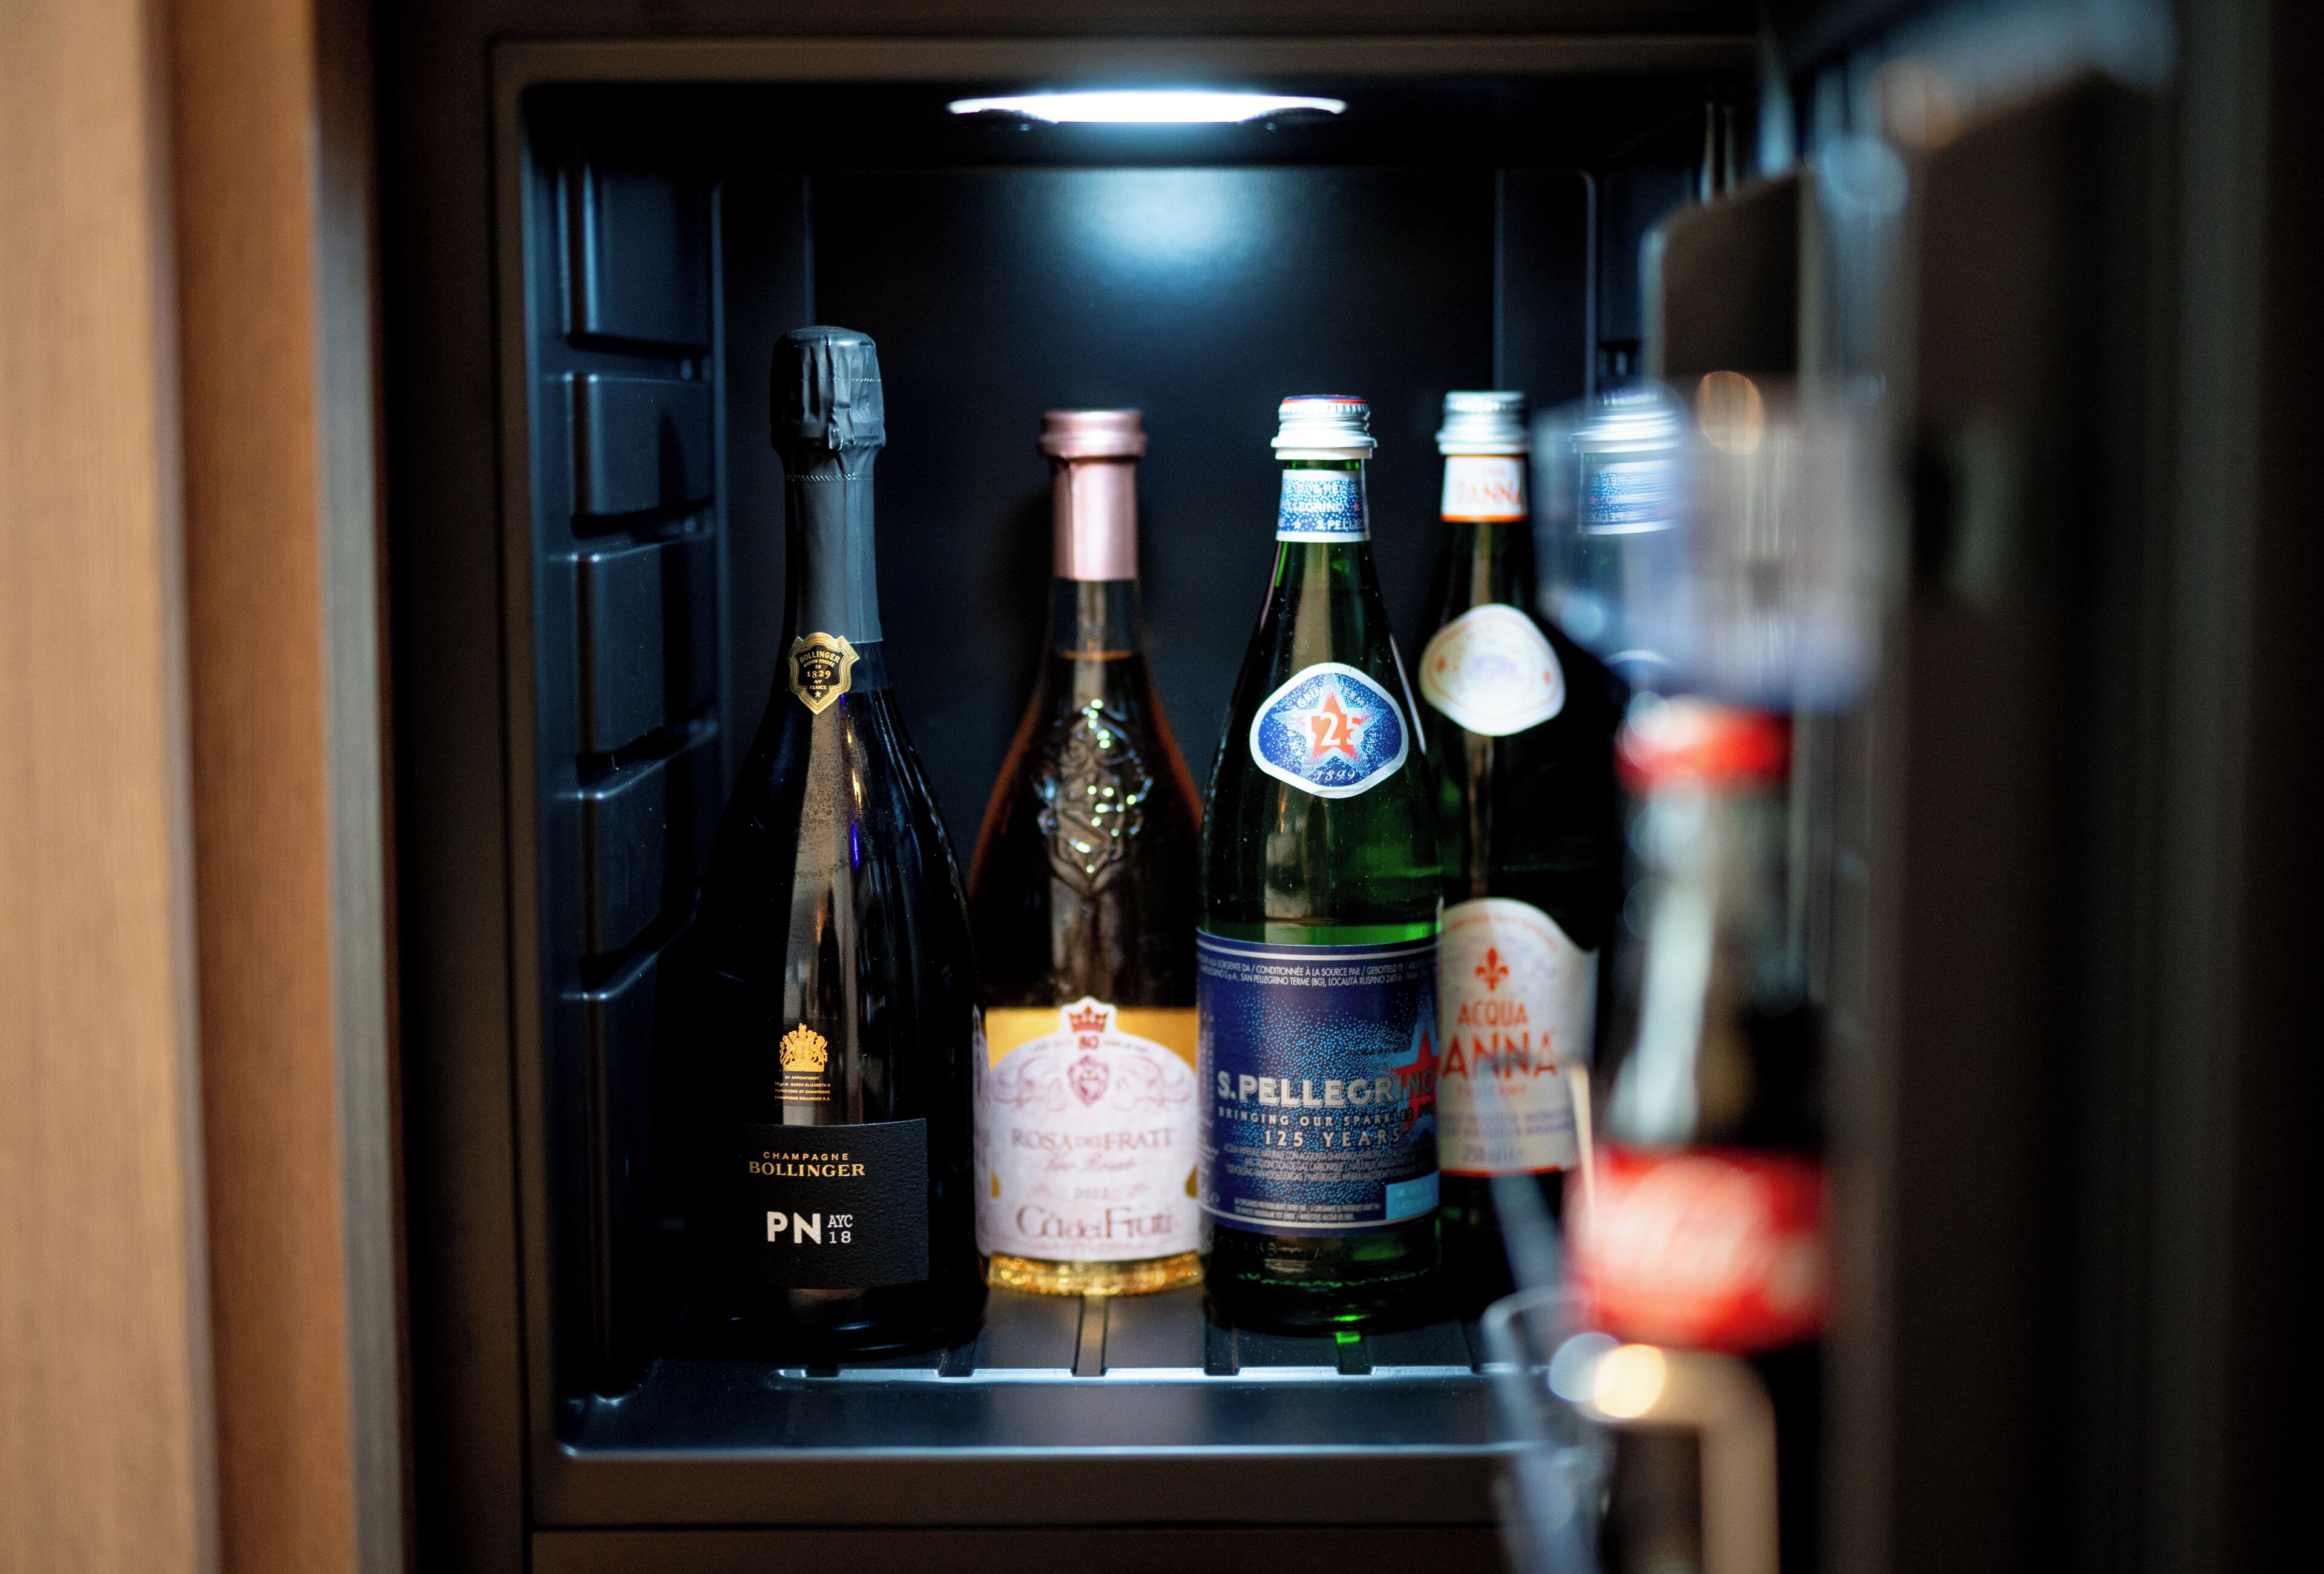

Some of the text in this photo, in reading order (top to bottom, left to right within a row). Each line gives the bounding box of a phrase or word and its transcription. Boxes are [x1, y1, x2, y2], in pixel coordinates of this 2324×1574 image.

[799, 651, 841, 664] BOLLINGER
[807, 670, 832, 679] 1829
[1316, 769, 1356, 782] 1899
[1242, 963, 1250, 972] DA
[1256, 965, 1304, 976] CONDITIONNÉE
[1305, 966, 1311, 976] À
[1321, 968, 1348, 976] SOURCE
[1349, 967, 1360, 976] PAR
[1241, 973, 1253, 983] SAN
[1253, 975, 1288, 986] PELLEGRINO
[1290, 977, 1310, 986] TERME
[1328, 976, 1358, 986] LOCALITÀ
[1359, 975, 1385, 986] RUSPINO
[1457, 998, 1530, 1027] ACQUA
[1217, 1068, 1435, 1108] S.PELLEGRINO
[1218, 1105, 1290, 1126] BRINGING
[1299, 1116, 1333, 1127] OUR
[1264, 1127, 1400, 1148] 125 YEARS
[763, 1151, 849, 1161] CHAMPAGNE
[749, 1161, 865, 1177] BOLLINGER
[827, 1214, 853, 1228] AYC
[767, 1211, 821, 1245] PN
[829, 1231, 852, 1243] 18
